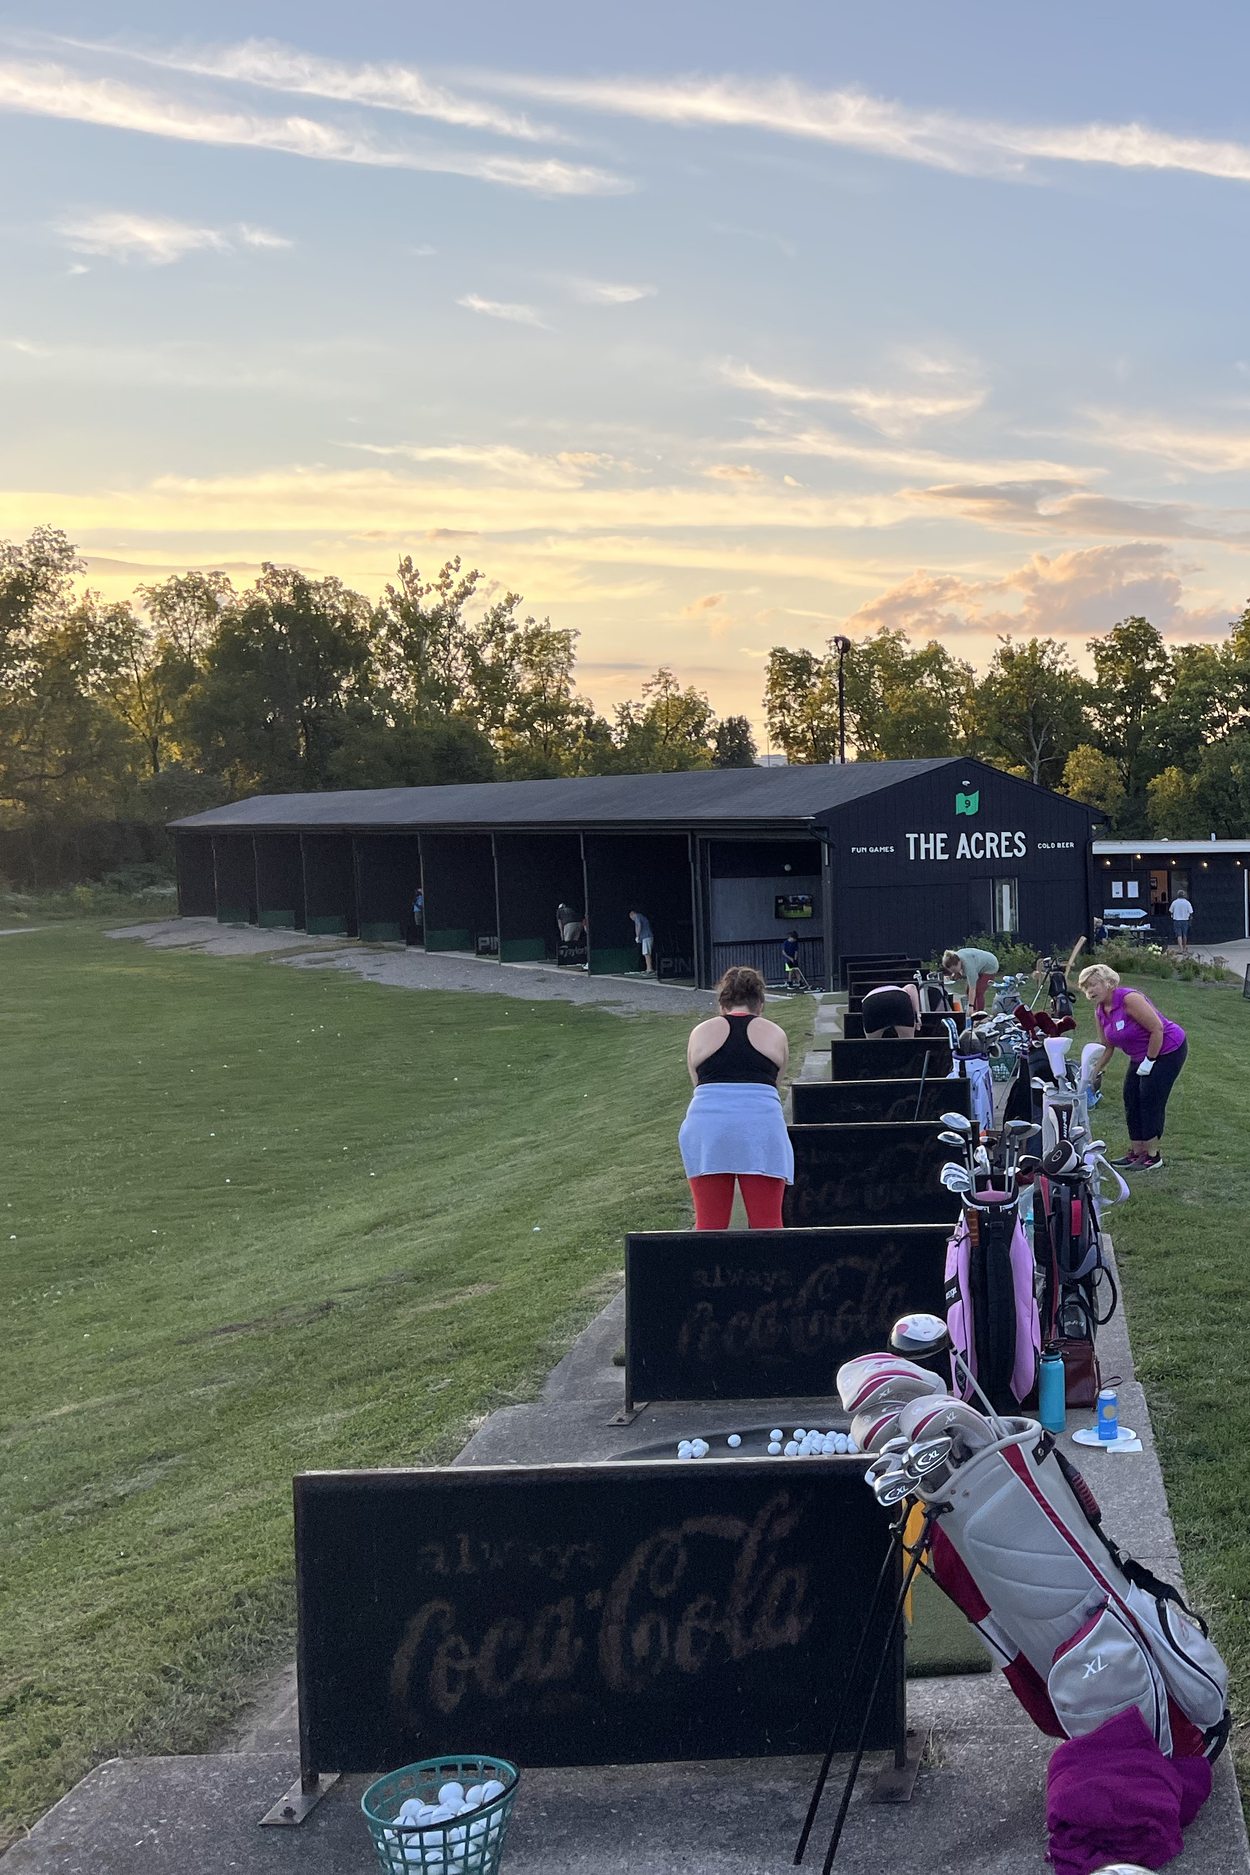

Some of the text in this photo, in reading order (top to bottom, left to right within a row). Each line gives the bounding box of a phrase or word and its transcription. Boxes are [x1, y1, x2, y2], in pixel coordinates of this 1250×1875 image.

[964, 799, 971, 809] 9
[905, 831, 1027, 860] THE ACRES
[559, 945, 587, 958] Taylor
[660, 956, 692, 974] PIN
[417, 1533, 605, 1580] always
[389, 1489, 816, 1725] Coca-Cola
[1082, 1655, 1109, 1679] XL
